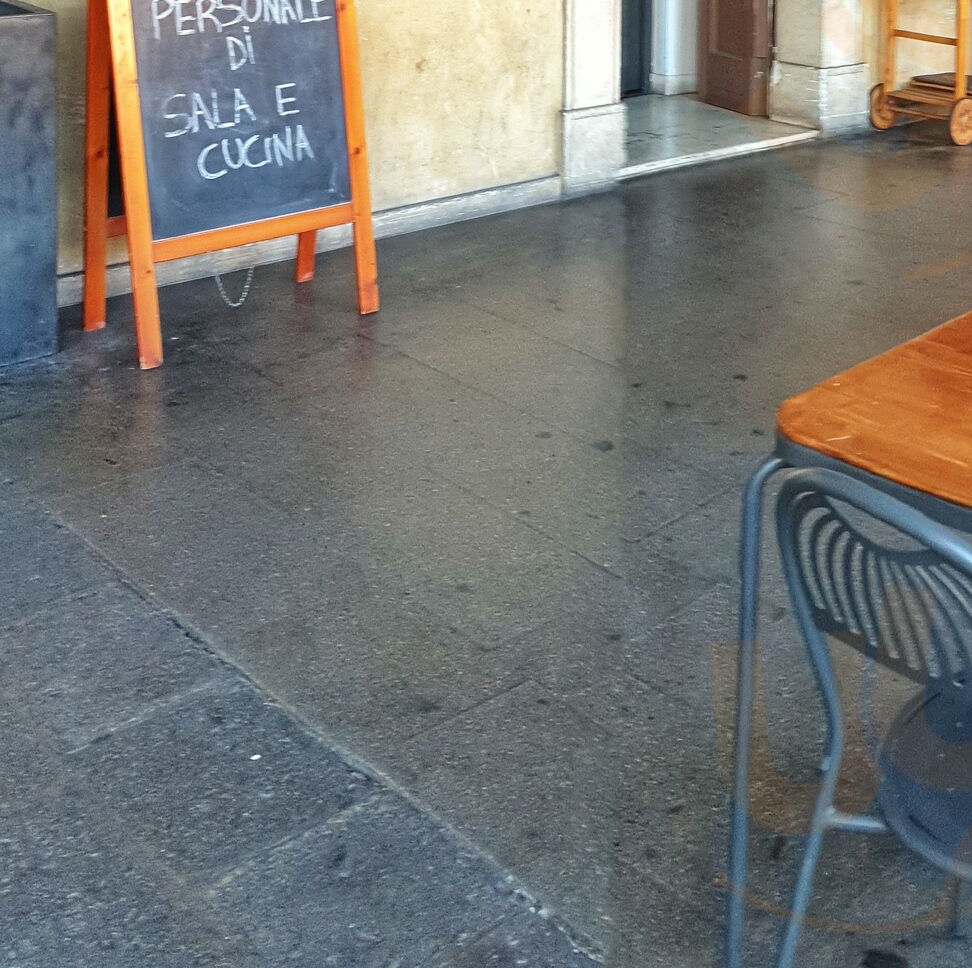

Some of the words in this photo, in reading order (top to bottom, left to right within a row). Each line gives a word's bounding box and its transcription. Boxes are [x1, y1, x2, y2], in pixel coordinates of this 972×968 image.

[164, 88, 257, 138] SALA
[274, 83, 300, 116] E
[197, 125, 314, 179] CUCINA
